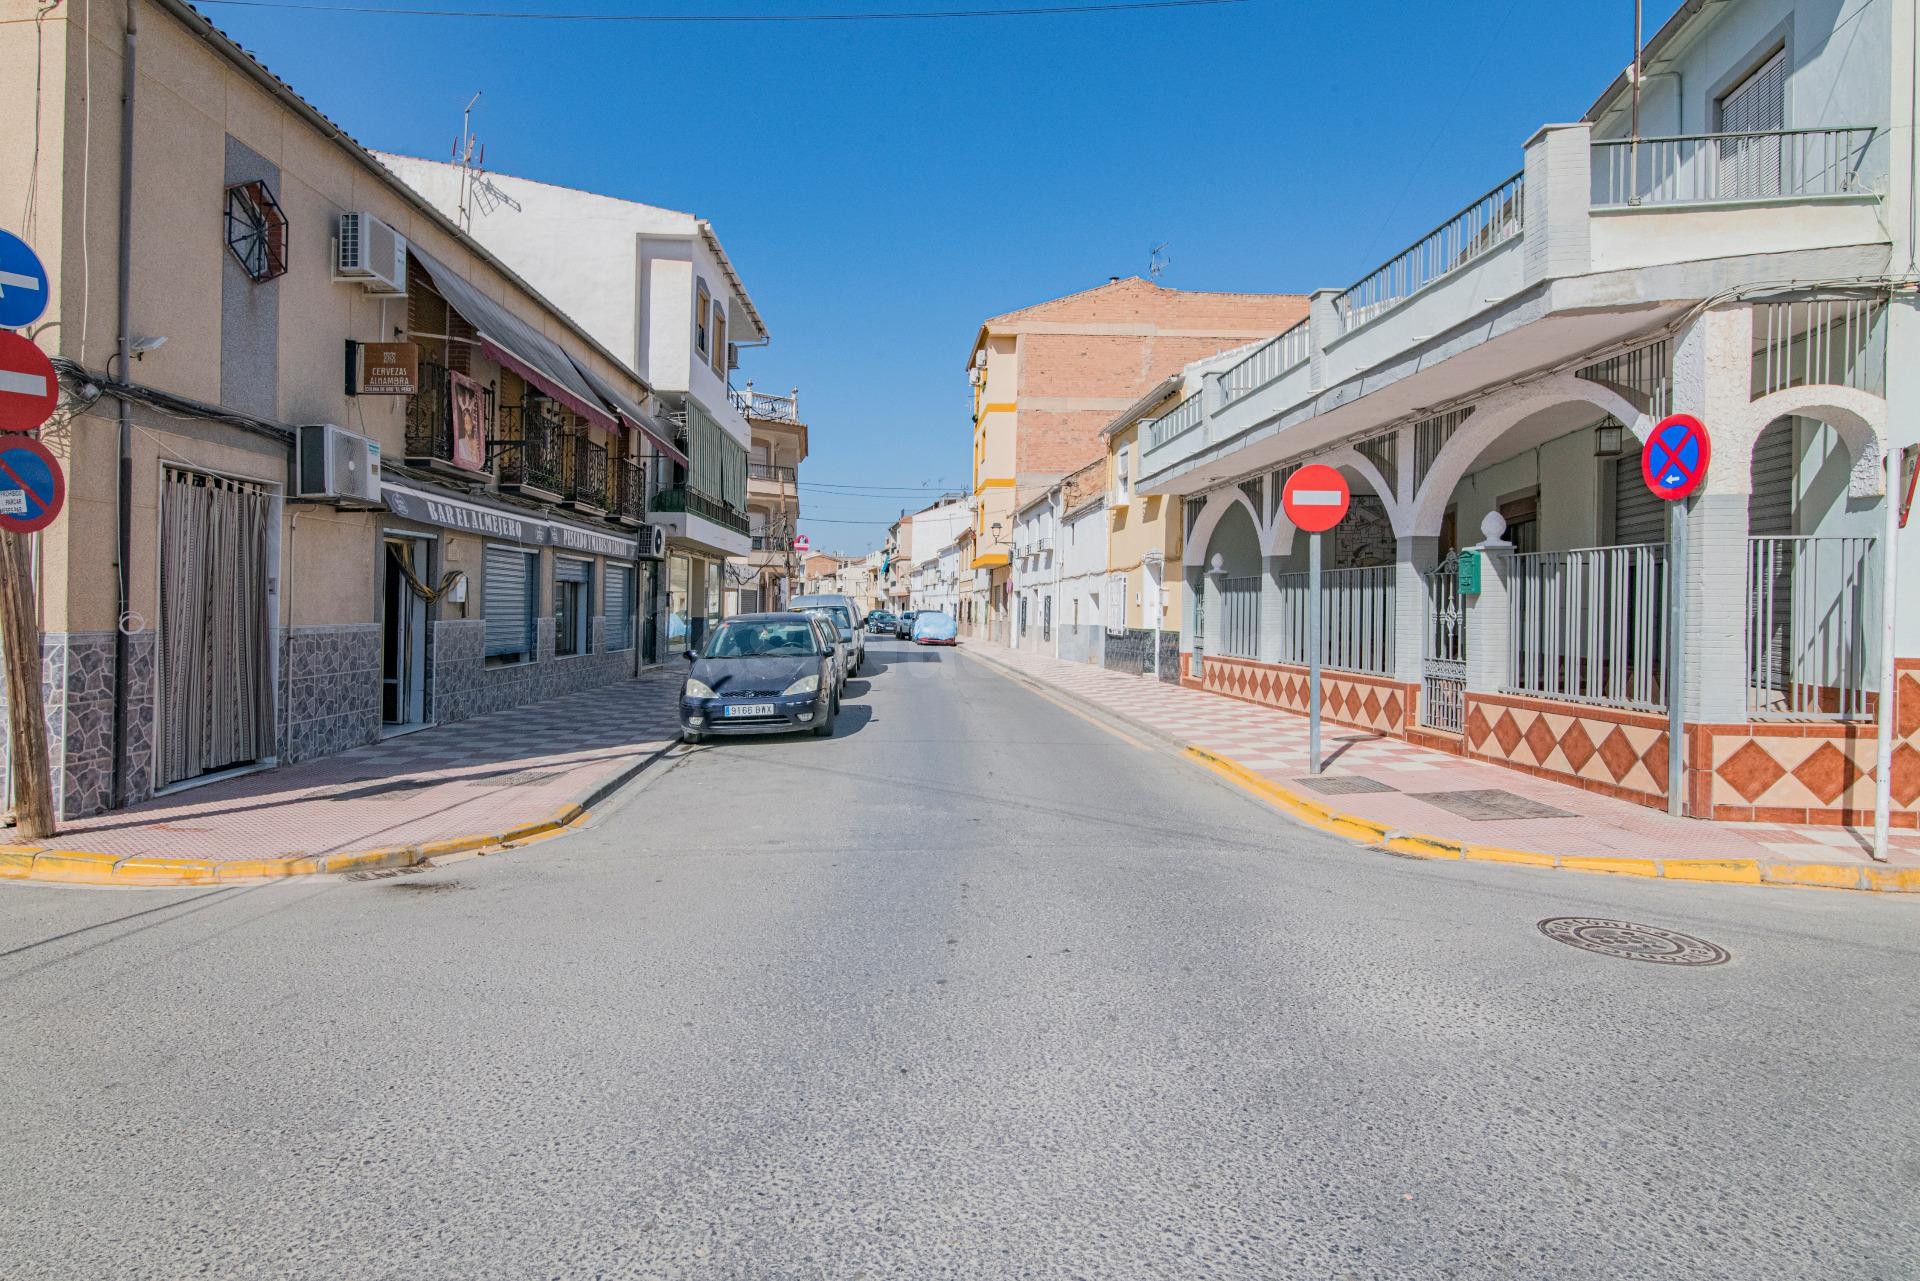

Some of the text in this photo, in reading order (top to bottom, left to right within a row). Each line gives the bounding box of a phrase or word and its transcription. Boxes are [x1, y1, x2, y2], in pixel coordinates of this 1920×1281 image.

[372, 368, 407, 376] CERVEZAS
[426, 501, 456, 525] BAR
[456, 508, 470, 528] EL
[471, 511, 522, 538] ALMEJERO
